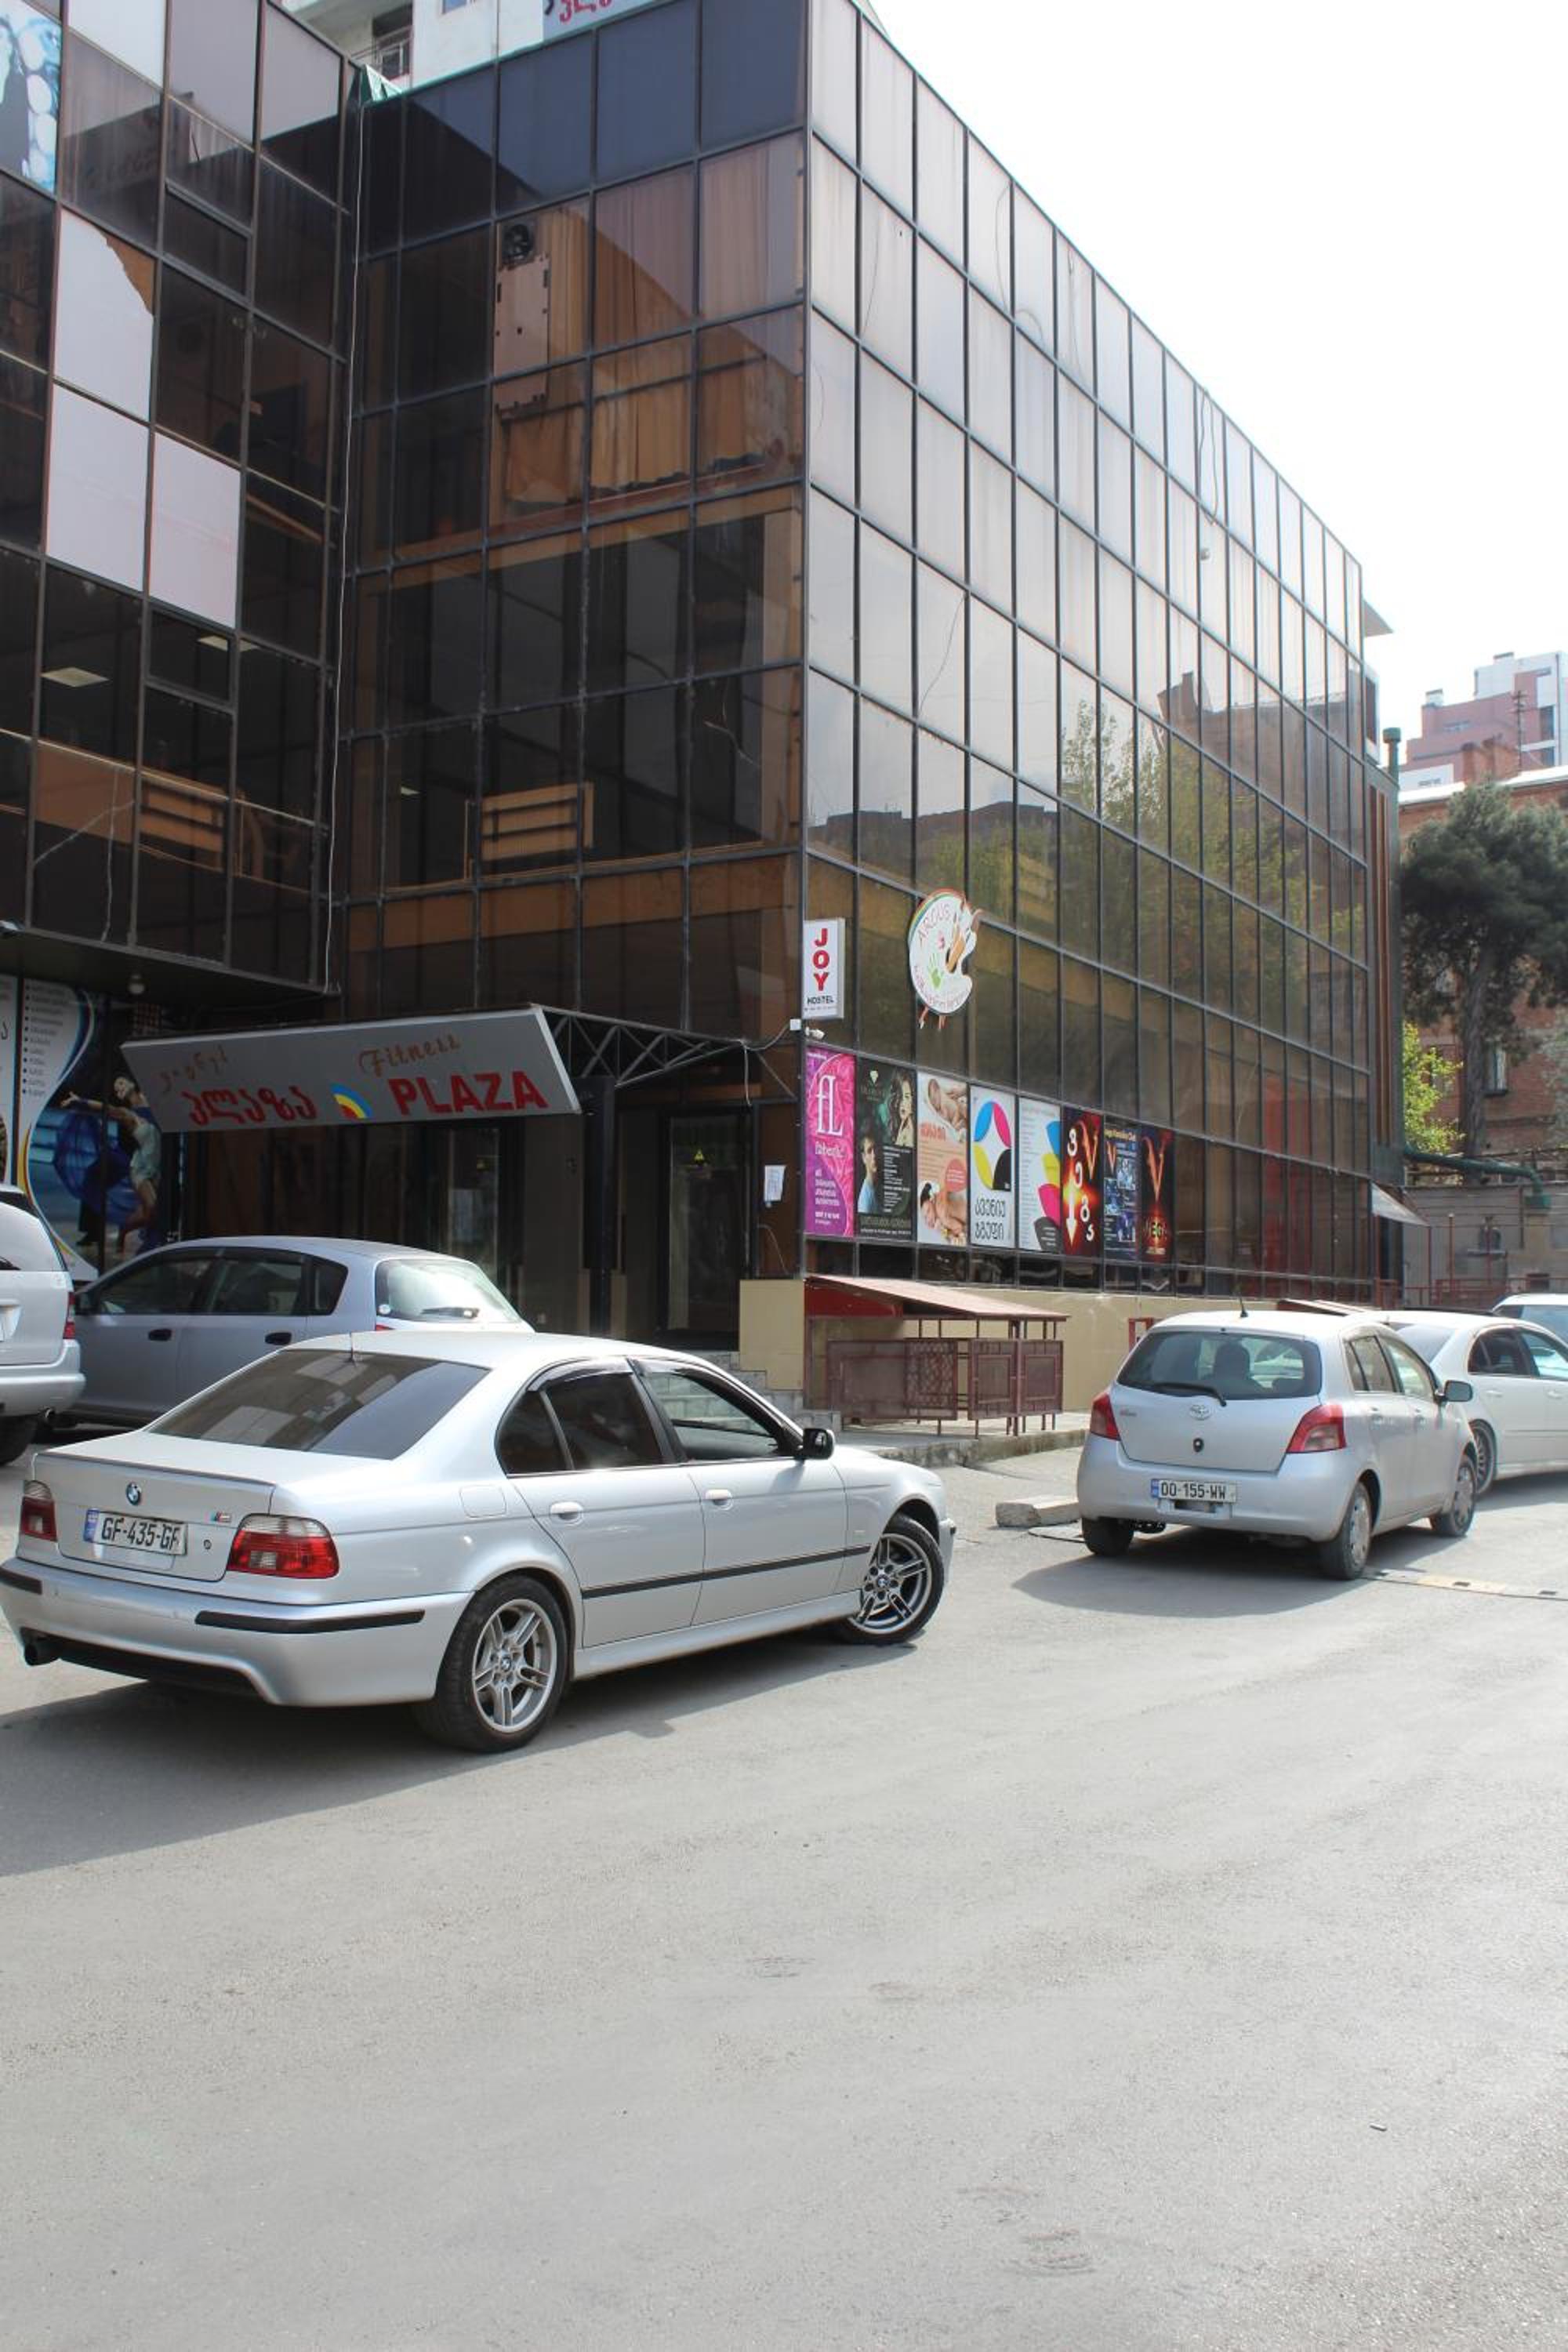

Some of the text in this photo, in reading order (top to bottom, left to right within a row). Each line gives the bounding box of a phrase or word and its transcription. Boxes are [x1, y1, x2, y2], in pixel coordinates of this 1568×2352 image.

[813, 927, 830, 992] JOY
[807, 995, 834, 1004] HOSTEL
[181, 1085, 318, 1126] პლაზა
[388, 1071, 548, 1116] PLAZA
[101, 1516, 181, 1550] GF-435-GF
